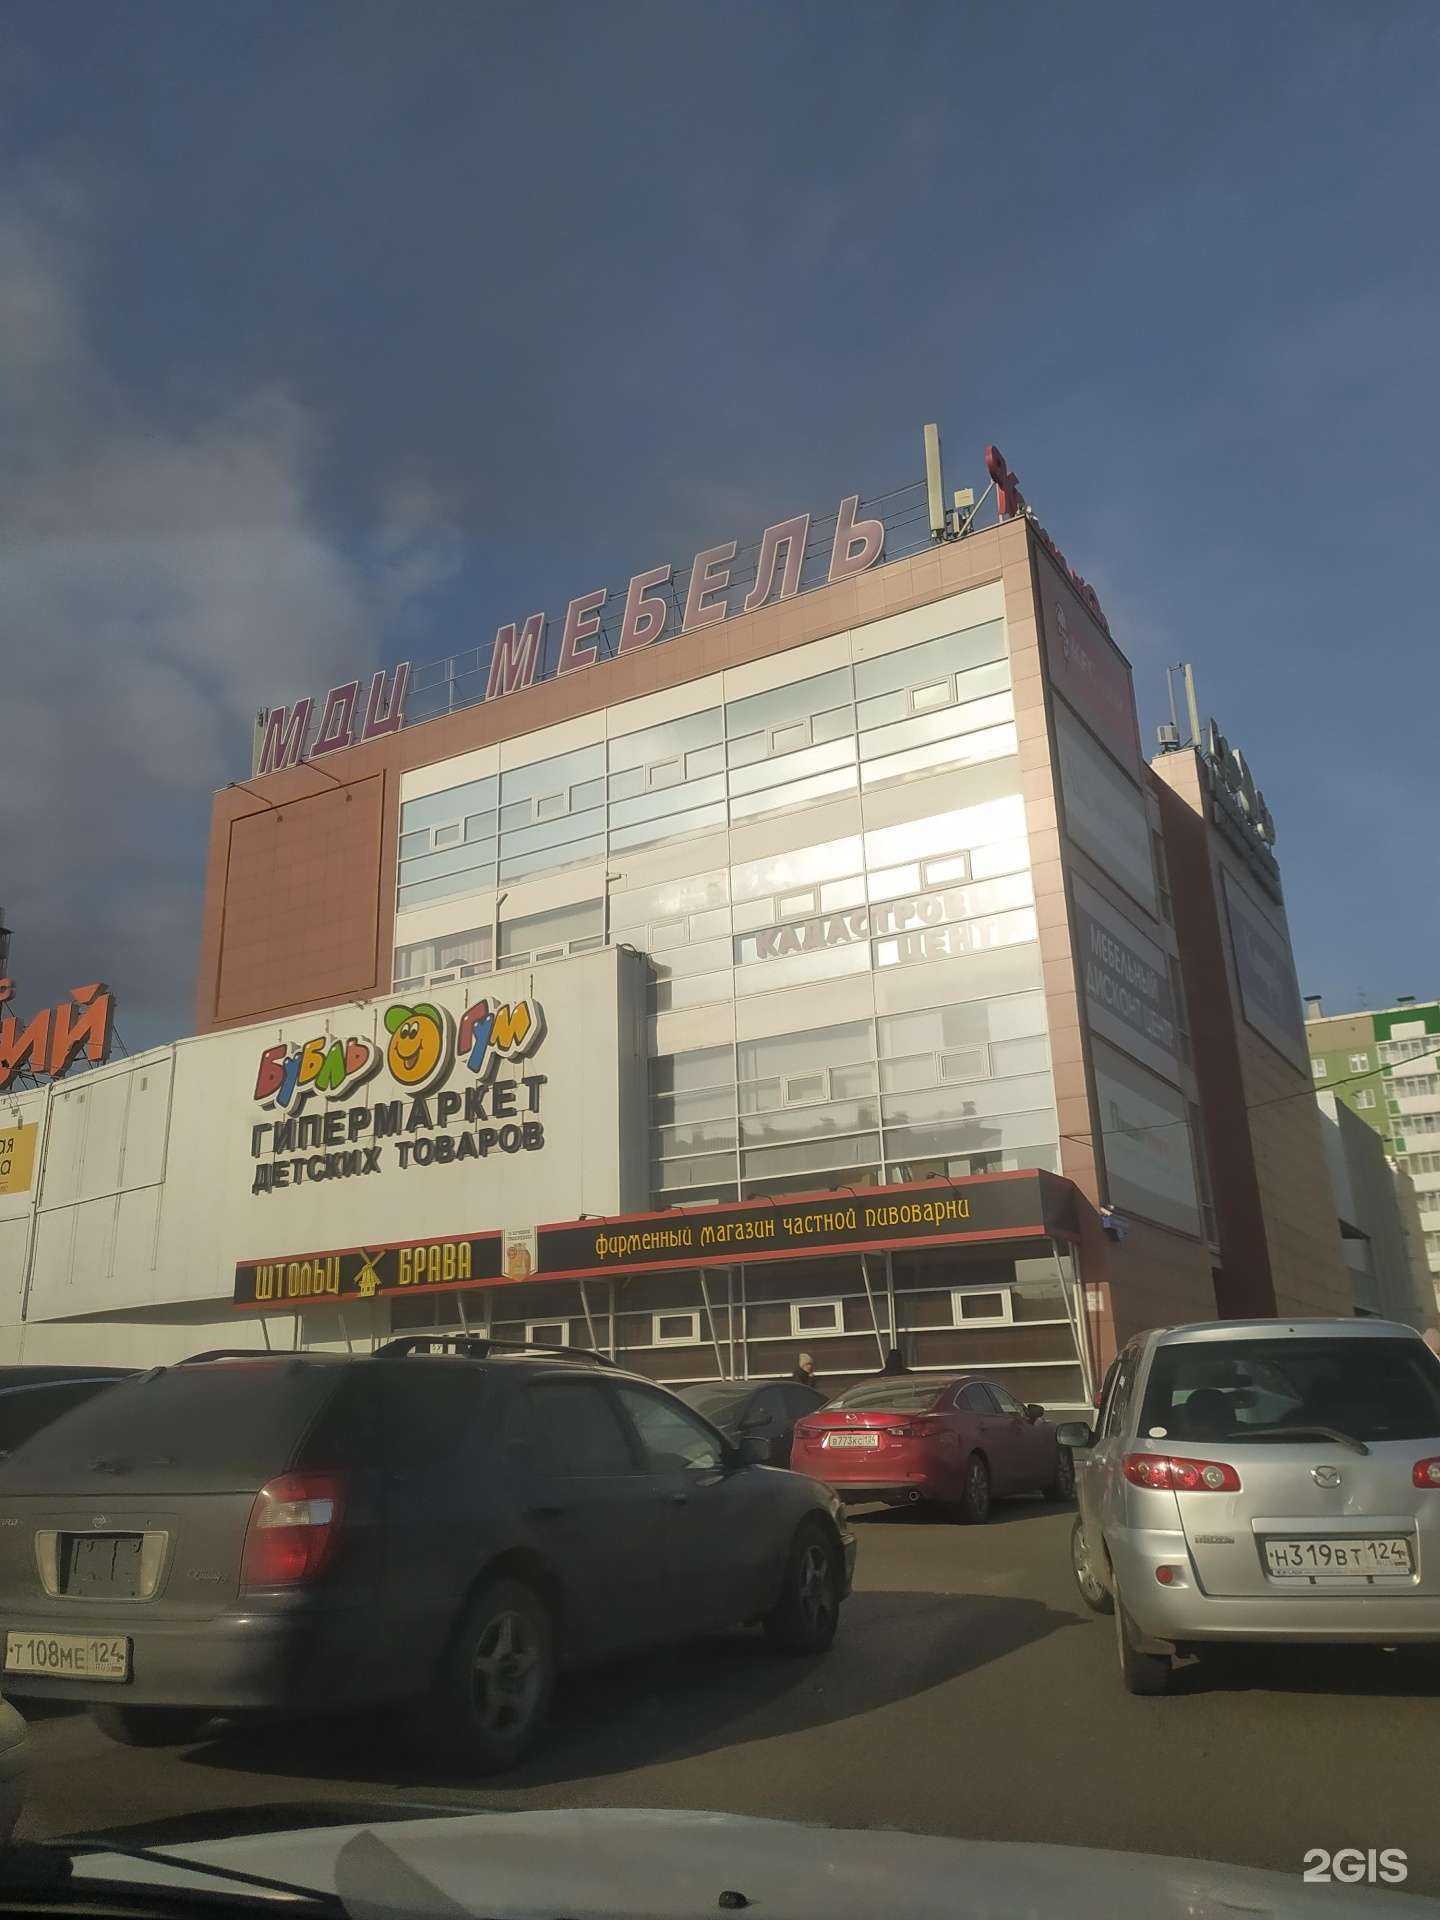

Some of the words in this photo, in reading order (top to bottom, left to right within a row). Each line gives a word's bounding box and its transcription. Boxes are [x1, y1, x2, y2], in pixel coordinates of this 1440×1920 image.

[256, 660, 411, 776] МДЦ
[485, 494, 885, 701] МЕБЕЛЬ
[251, 1075, 547, 1158] ГИПЕРМАРКЕТ
[251, 1145, 382, 1195] ДЕТСКИХ
[395, 1120, 545, 1169] ТОВАРОВ
[398, 1242, 472, 1285] БРАВА
[595, 1226, 693, 1259] фирменный
[701, 1219, 776, 1248] магазин
[782, 1206, 857, 1236] частной
[865, 1197, 971, 1228] пивоварни
